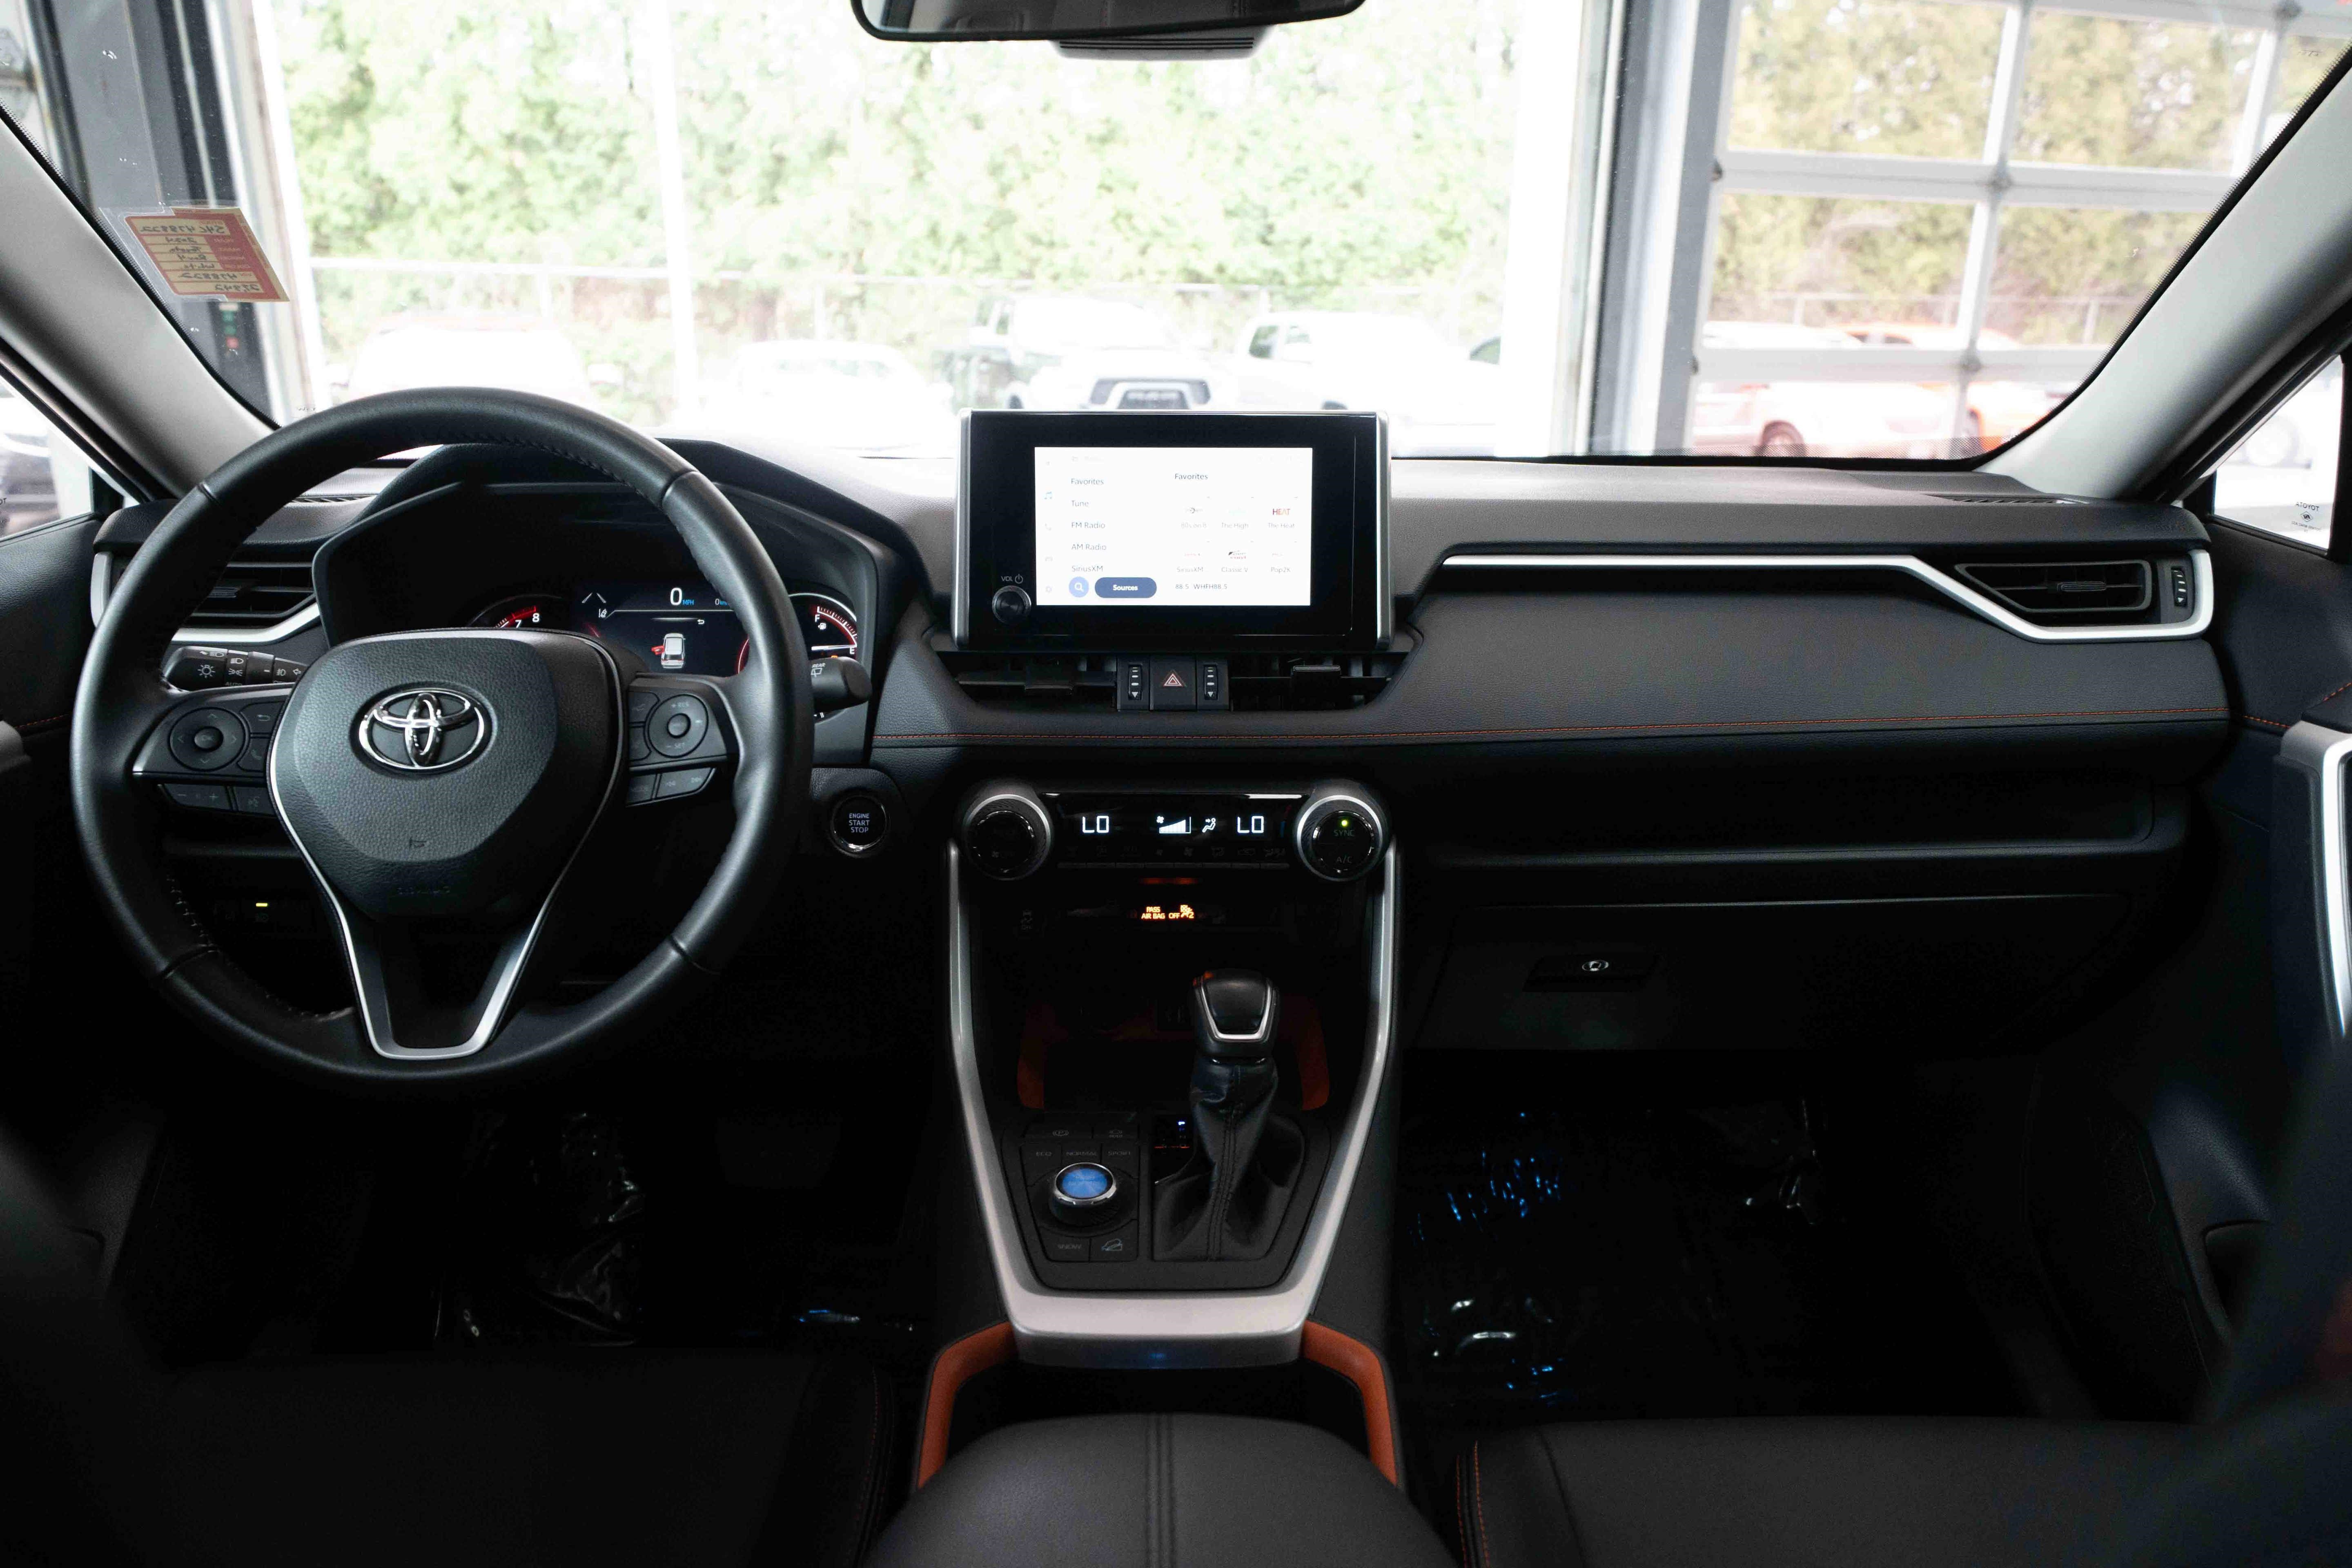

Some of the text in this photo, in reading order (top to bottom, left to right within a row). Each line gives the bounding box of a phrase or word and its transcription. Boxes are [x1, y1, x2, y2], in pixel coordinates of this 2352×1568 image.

[670, 587, 682, 605] 0
[532, 612, 540, 622] 8
[815, 614, 820, 623] F
[515, 619, 522, 628] 7
[1082, 815, 1109, 833] LO
[1237, 815, 1264, 833] LO
[1336, 855, 1352, 864] A/C
